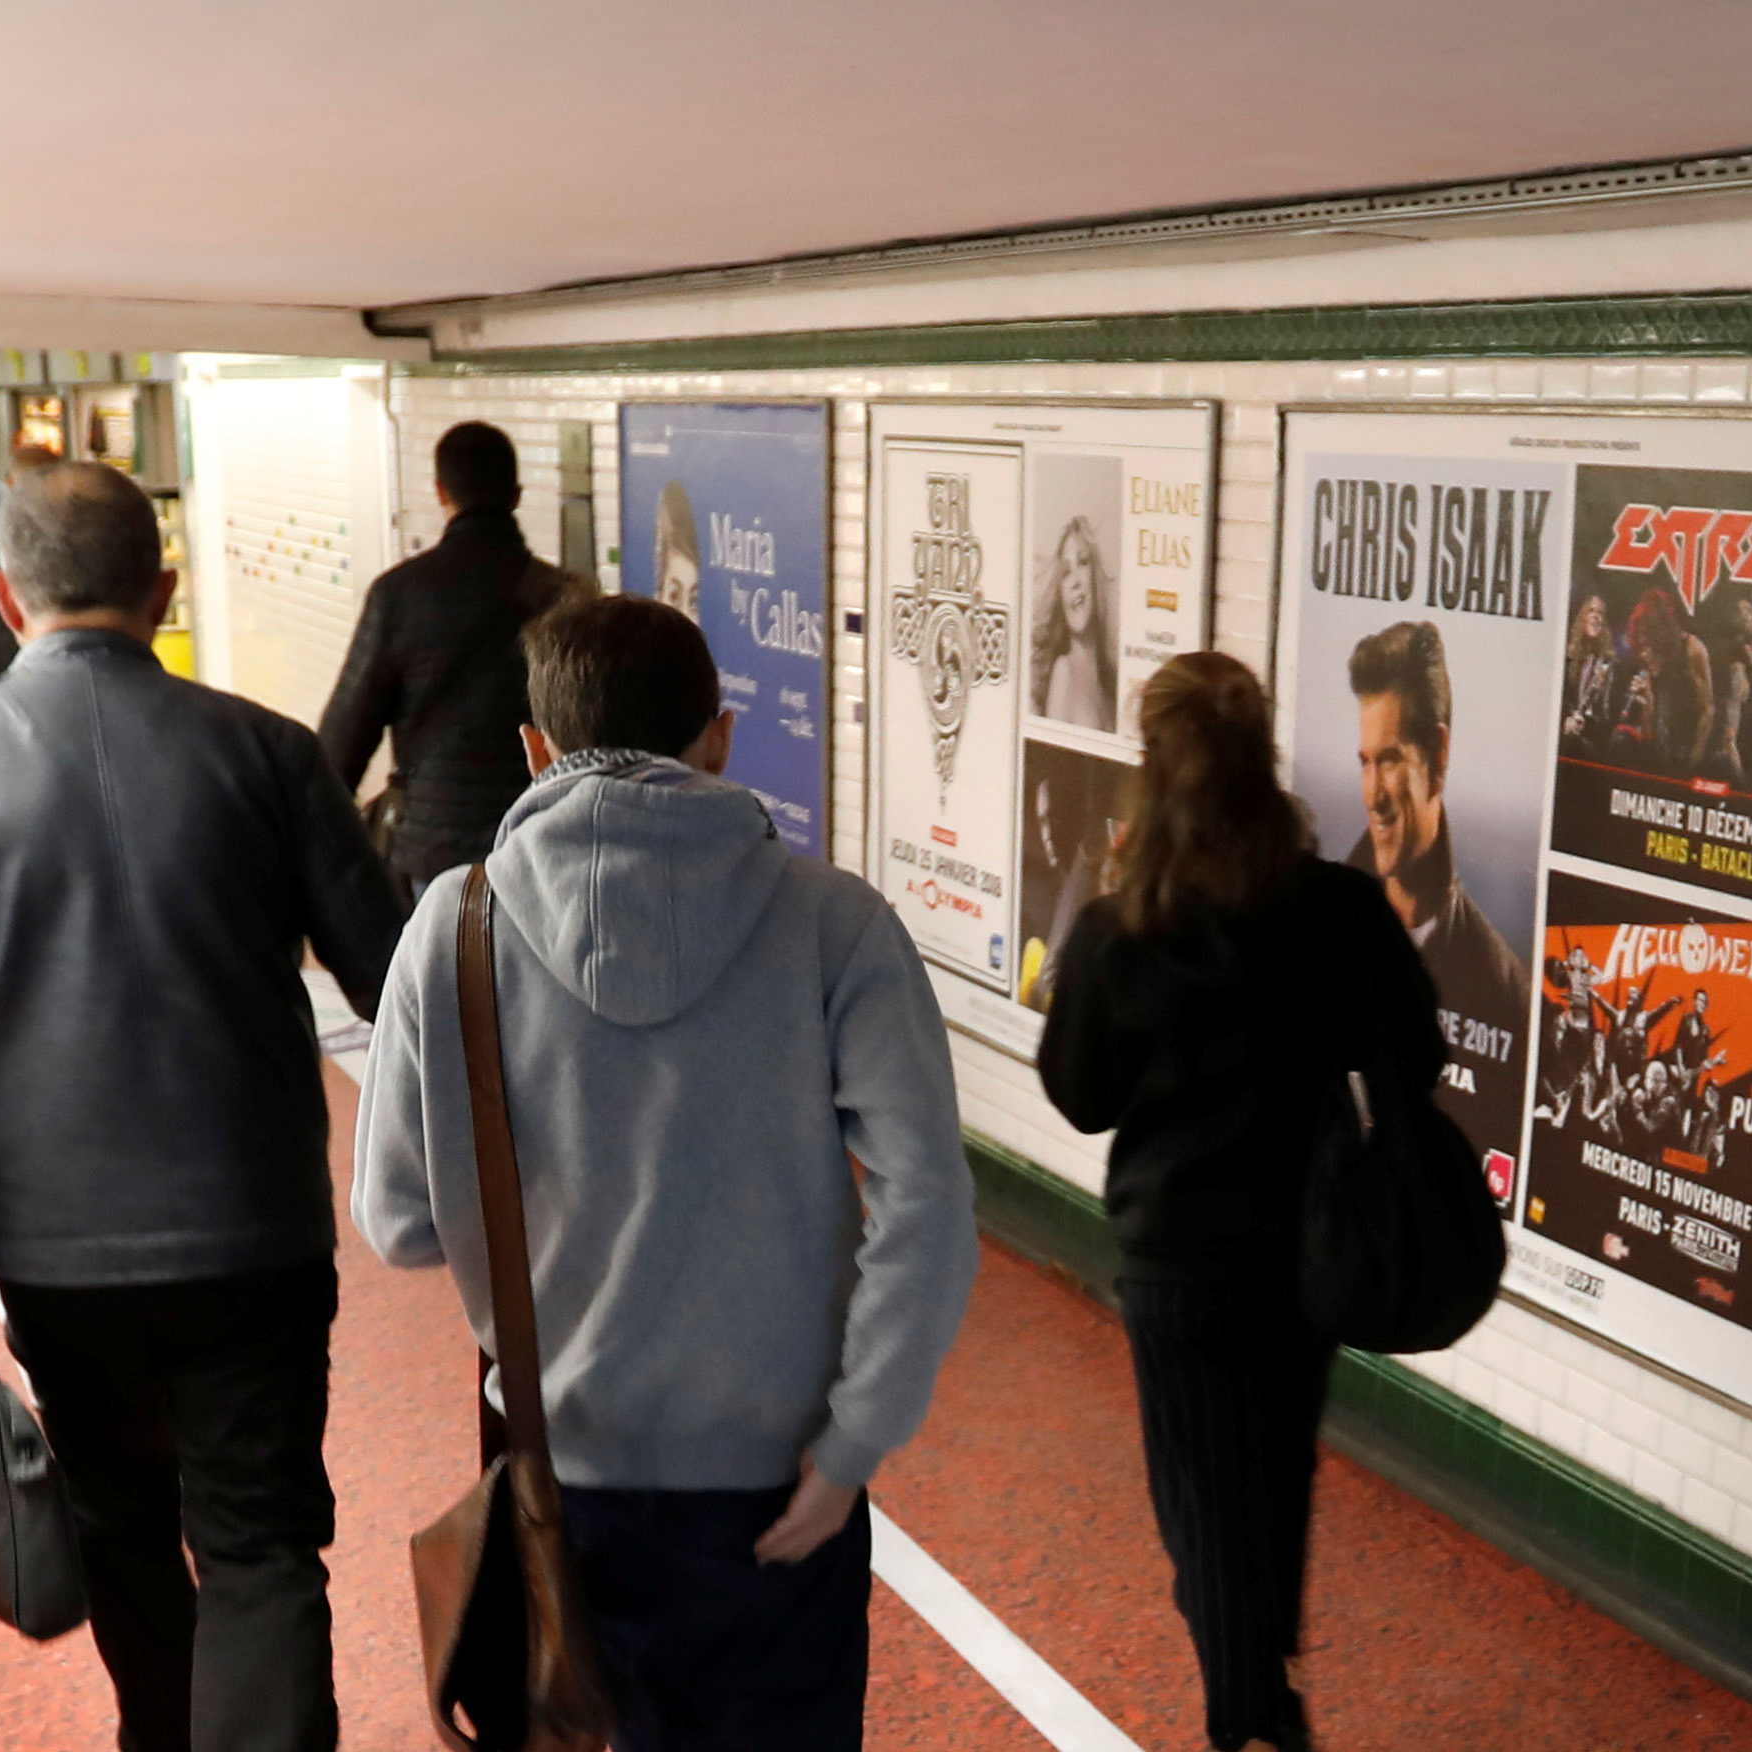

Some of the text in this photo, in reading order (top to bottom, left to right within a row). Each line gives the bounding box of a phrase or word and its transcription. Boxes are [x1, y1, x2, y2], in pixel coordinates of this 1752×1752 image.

[1130, 475, 1202, 517] ELIANE
[709, 512, 776, 576] Maria
[1138, 528, 1192, 569] ELIAS
[1310, 478, 1552, 622] CHRIS ISAAK
[751, 587, 823, 658] Callas
[1609, 788, 1685, 830] DIMANCHE
[1687, 804, 1704, 833] 10
[1646, 830, 1689, 865] PARIS
[1463, 1018, 1513, 1062] 2017
[1581, 1140, 1652, 1190] MERCREDI
[1654, 1168, 1671, 1198] 15
[1618, 1195, 1663, 1236] PARIS
[1672, 1215, 1741, 1258] ZENITH
